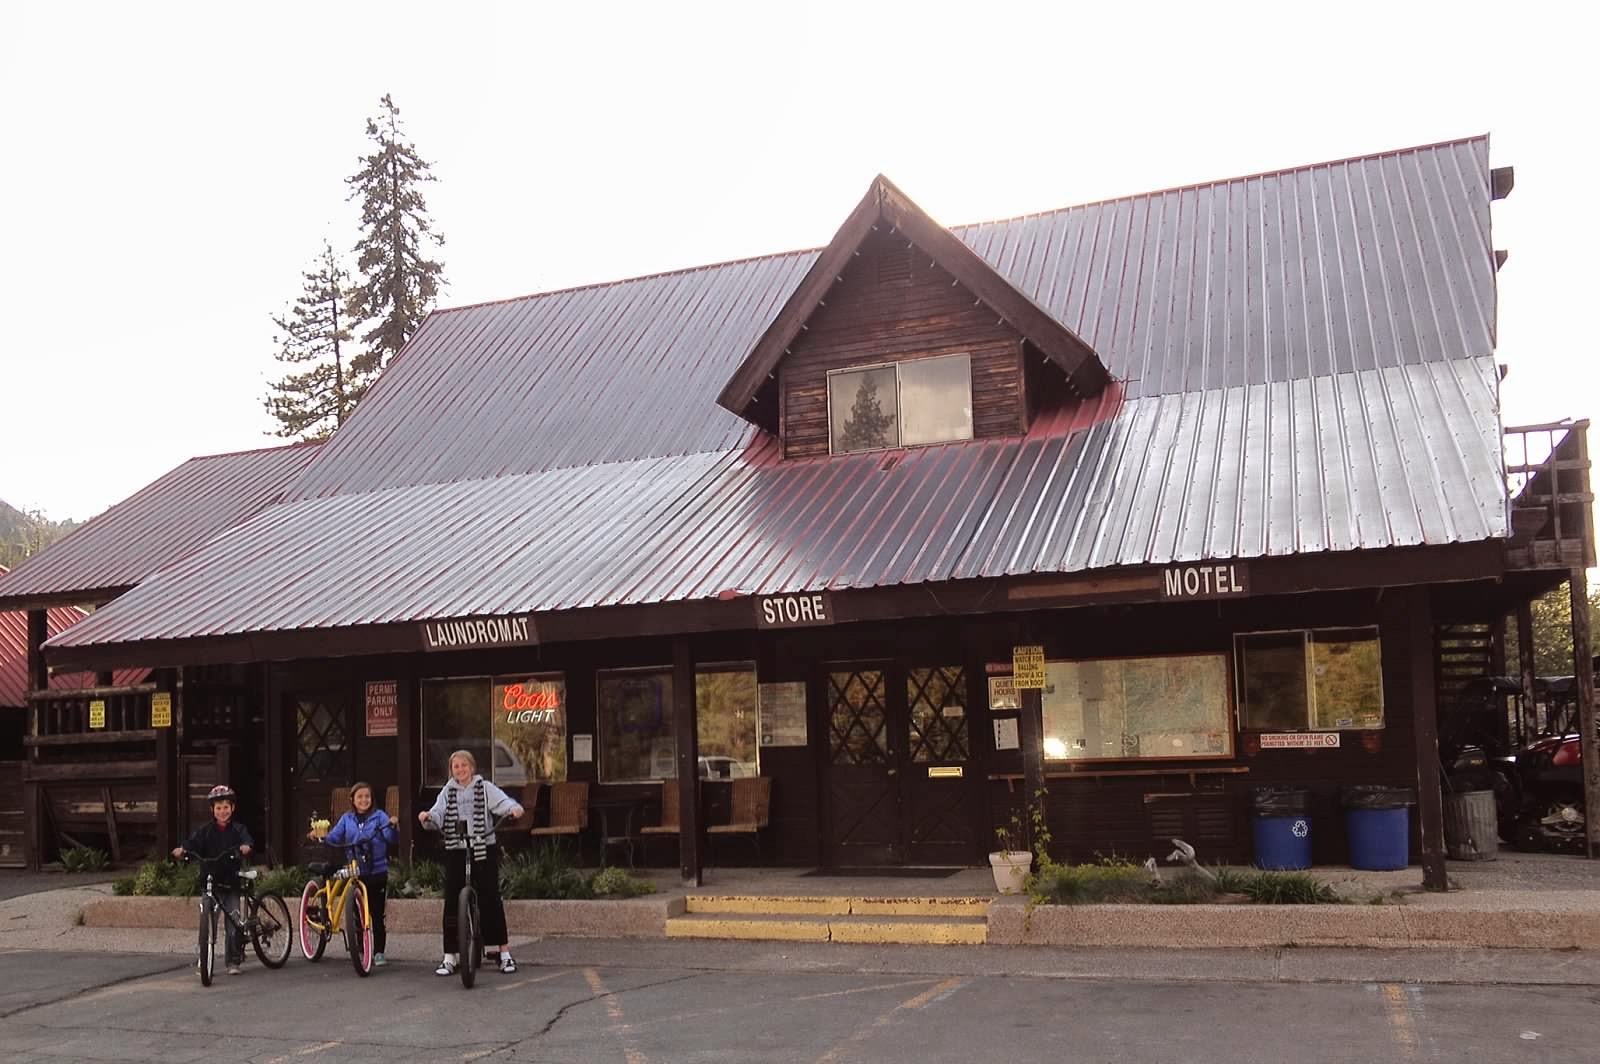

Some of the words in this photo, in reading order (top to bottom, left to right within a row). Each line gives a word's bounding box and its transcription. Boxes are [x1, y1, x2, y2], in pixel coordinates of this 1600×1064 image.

[1165, 565, 1243, 596] MOTEL
[762, 596, 826, 624] STORE
[426, 618, 529, 647] LAUNDROMAT
[1013, 646, 1043, 654] CAUTION
[1014, 655, 1031, 663] WATCH
[1015, 679, 1029, 687] FROM
[368, 684, 397, 695] PERMIT
[993, 688, 1016, 696] HOURS
[503, 683, 559, 710] Coors
[374, 706, 393, 717] ONLY
[507, 709, 555, 723] LIGHT
